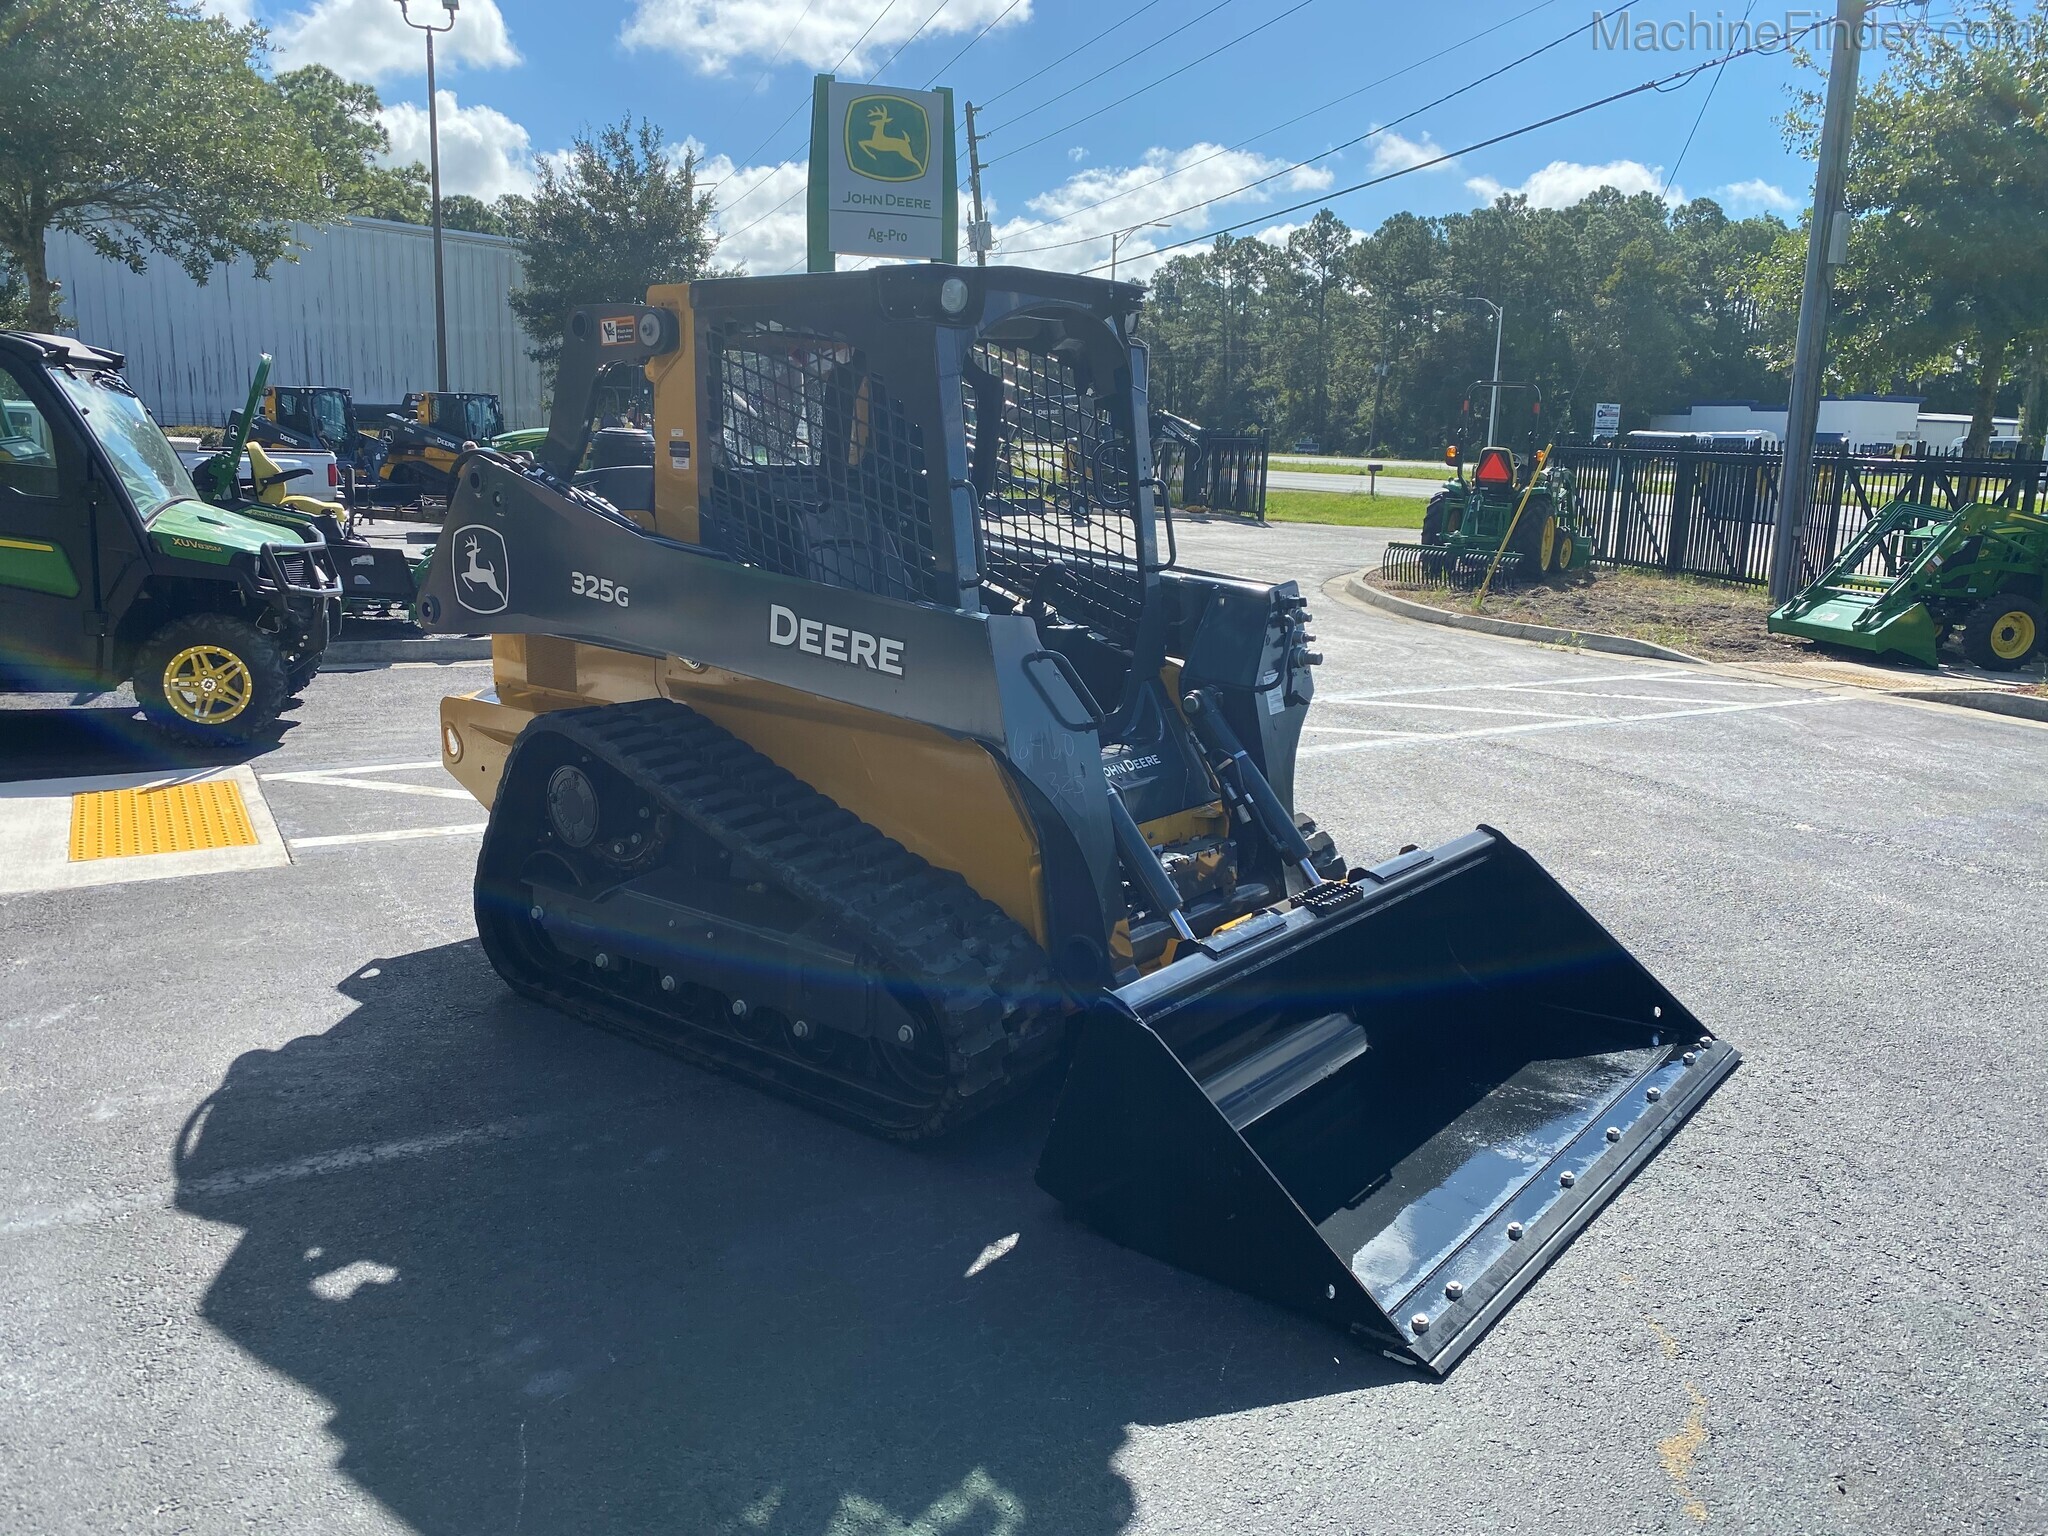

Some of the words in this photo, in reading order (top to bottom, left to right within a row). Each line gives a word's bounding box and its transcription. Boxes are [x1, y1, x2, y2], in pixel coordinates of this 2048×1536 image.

[842, 191, 883, 206] JOHN
[885, 193, 932, 210] DEERE
[867, 227, 908, 243] Ag-Pro
[279, 432, 299, 446] DEERE
[436, 436, 456, 449] DEERE
[571, 571, 629, 607] 325G
[769, 603, 904, 676] DEERE
[1102, 762, 1127, 778] OHN
[1124, 754, 1162, 772] DEERE
